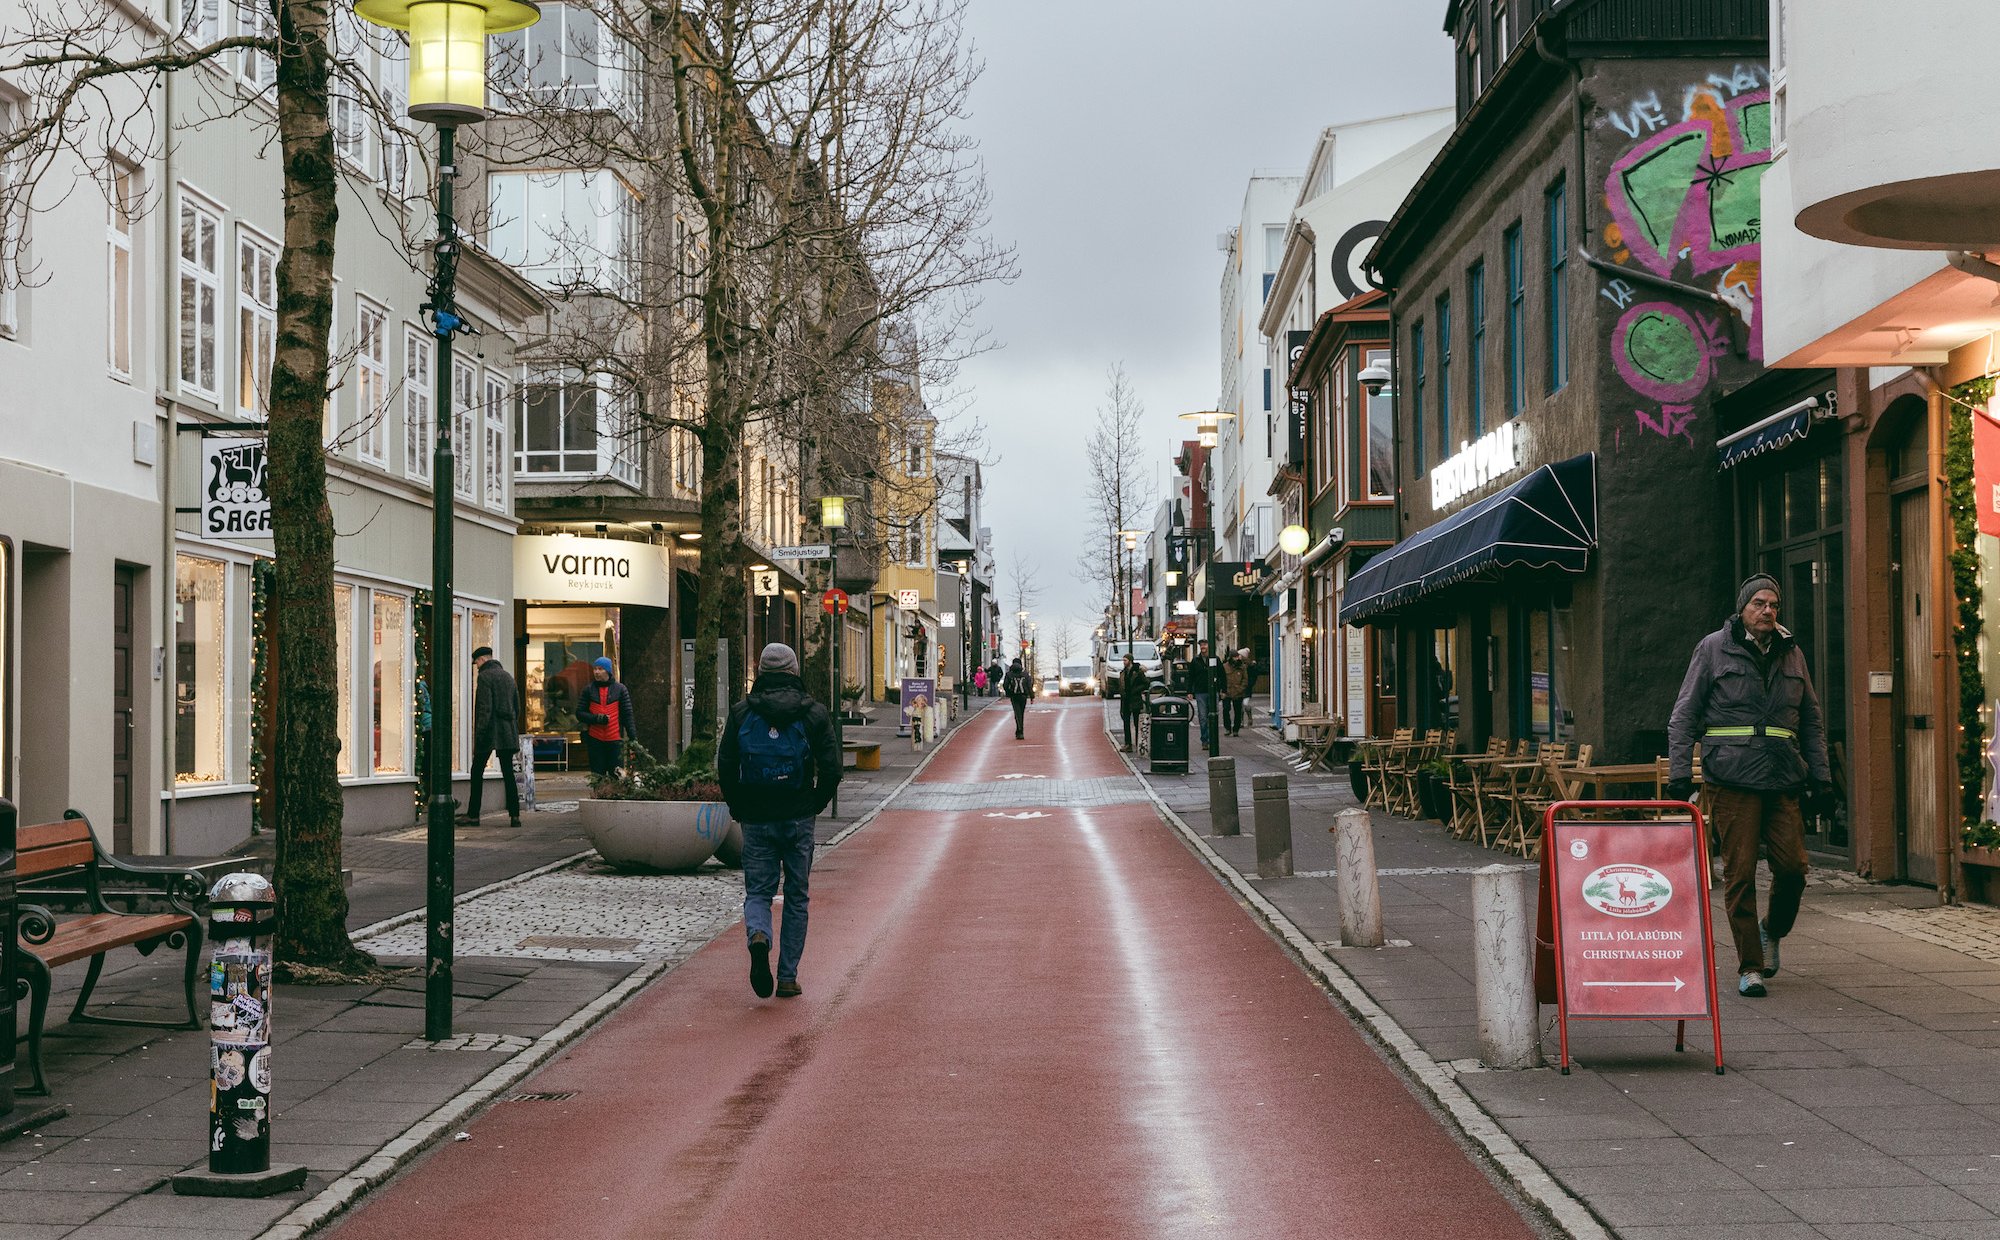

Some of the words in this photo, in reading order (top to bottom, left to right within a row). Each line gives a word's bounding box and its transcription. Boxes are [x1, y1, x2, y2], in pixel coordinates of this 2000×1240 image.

[208, 505, 272, 533] SAGA
[543, 554, 630, 578] varma
[1233, 568, 1261, 587] Gull
[1349, 628, 1361, 639] ELLY
[1580, 931, 1614, 940] LITLA
[1583, 949, 1649, 960] CHRISTMAS
[1652, 949, 1684, 960] SHOP
